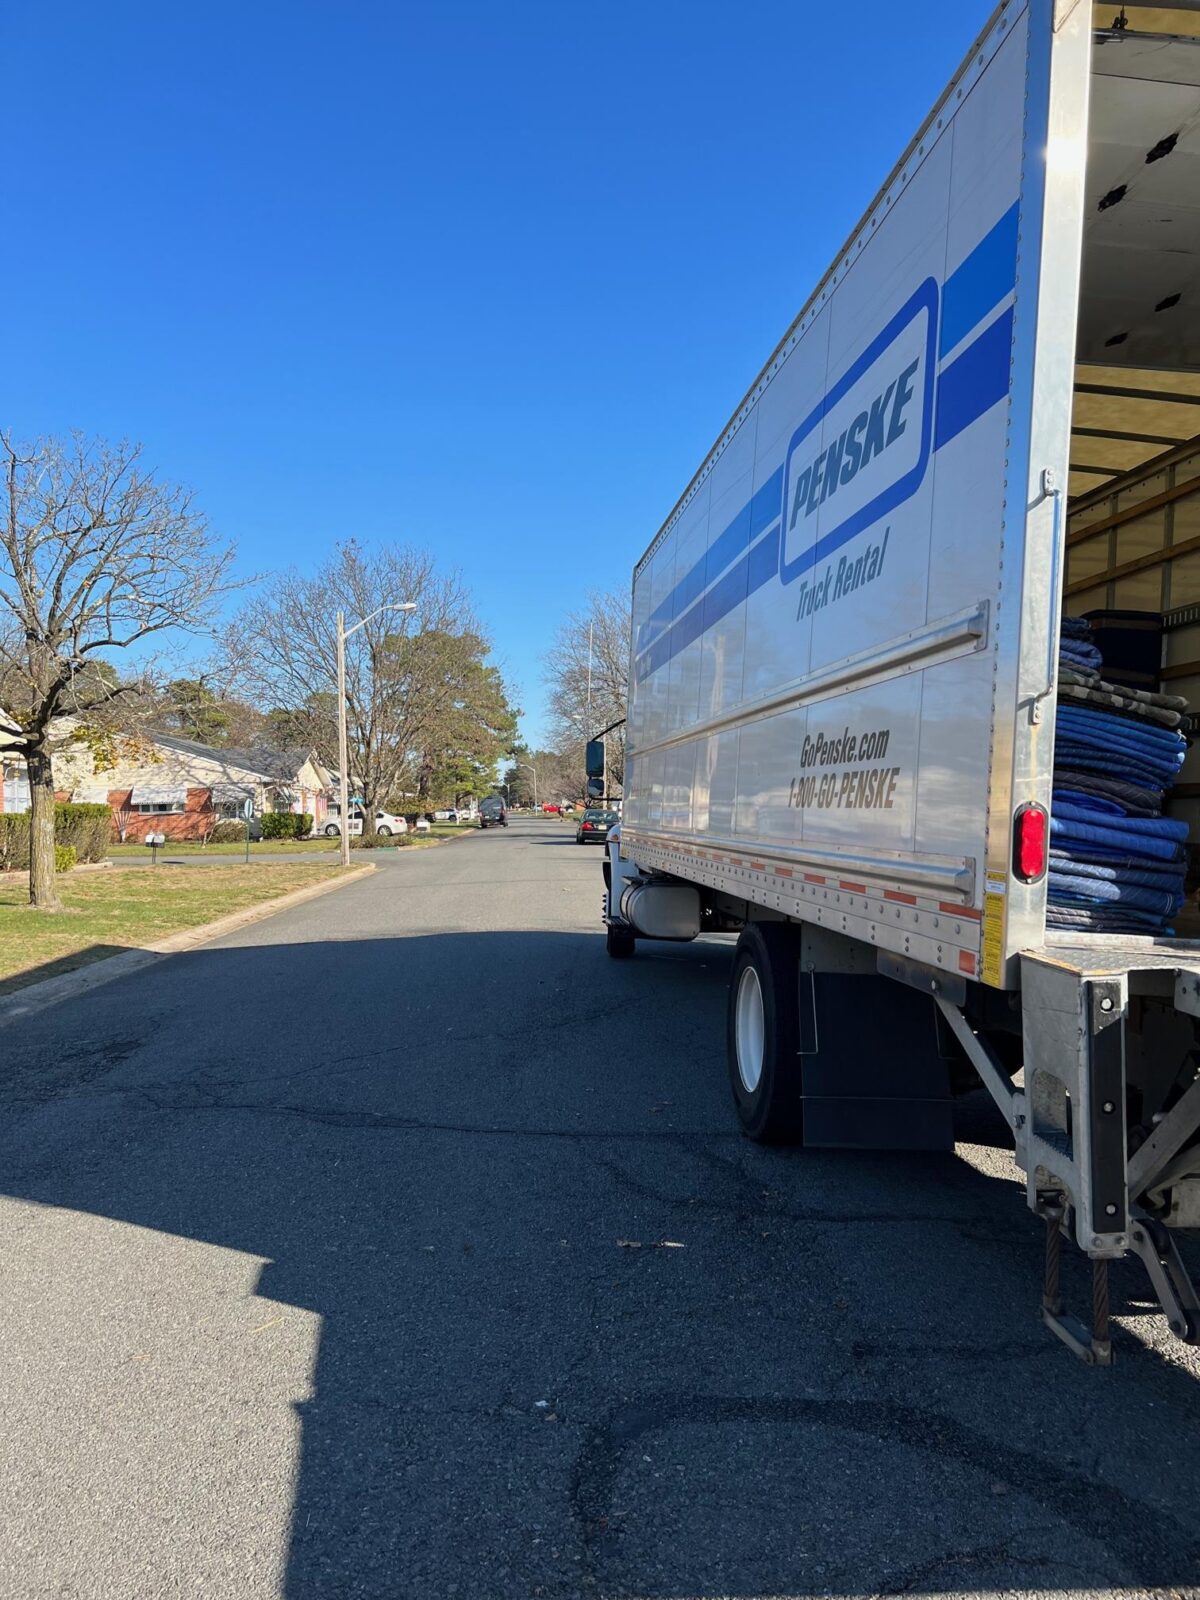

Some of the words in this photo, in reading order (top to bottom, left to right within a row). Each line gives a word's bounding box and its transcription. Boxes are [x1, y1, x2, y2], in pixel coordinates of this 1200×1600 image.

[789, 356, 920, 531] PENSKE
[796, 565, 833, 622] Truck
[832, 526, 890, 602] Rental
[800, 726, 890, 768] GoPenske.com
[788, 767, 900, 809] 1-800-GO-PENSKE
